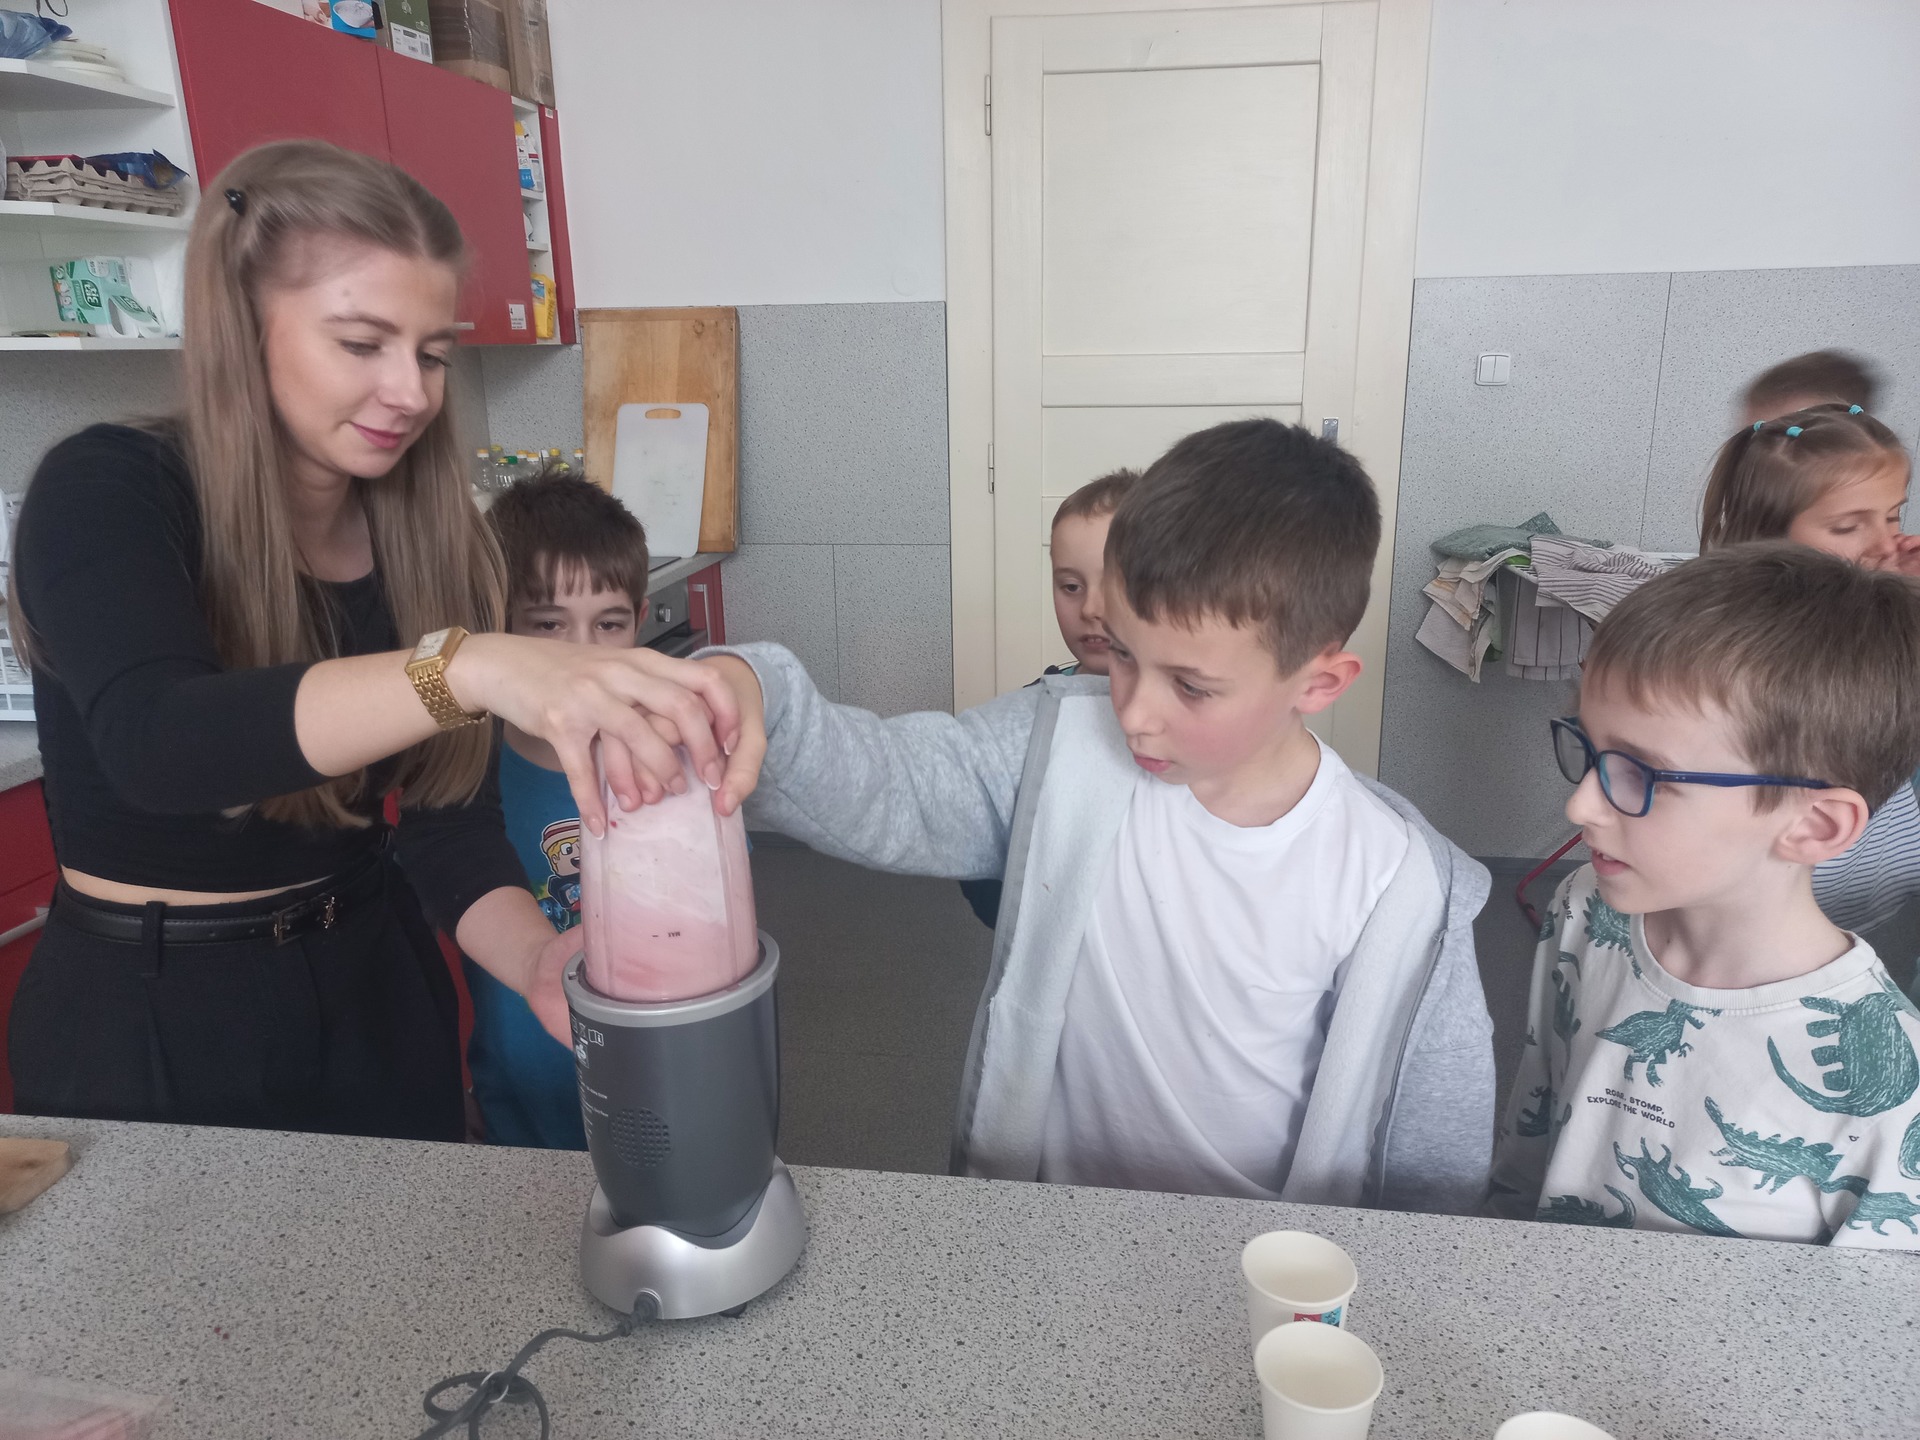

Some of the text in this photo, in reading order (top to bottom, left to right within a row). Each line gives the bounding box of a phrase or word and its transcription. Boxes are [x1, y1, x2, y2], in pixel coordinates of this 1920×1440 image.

[1586, 1095, 1676, 1129] EXPLORE THE WORLD
[1629, 1096, 1665, 1115] STOMP,
